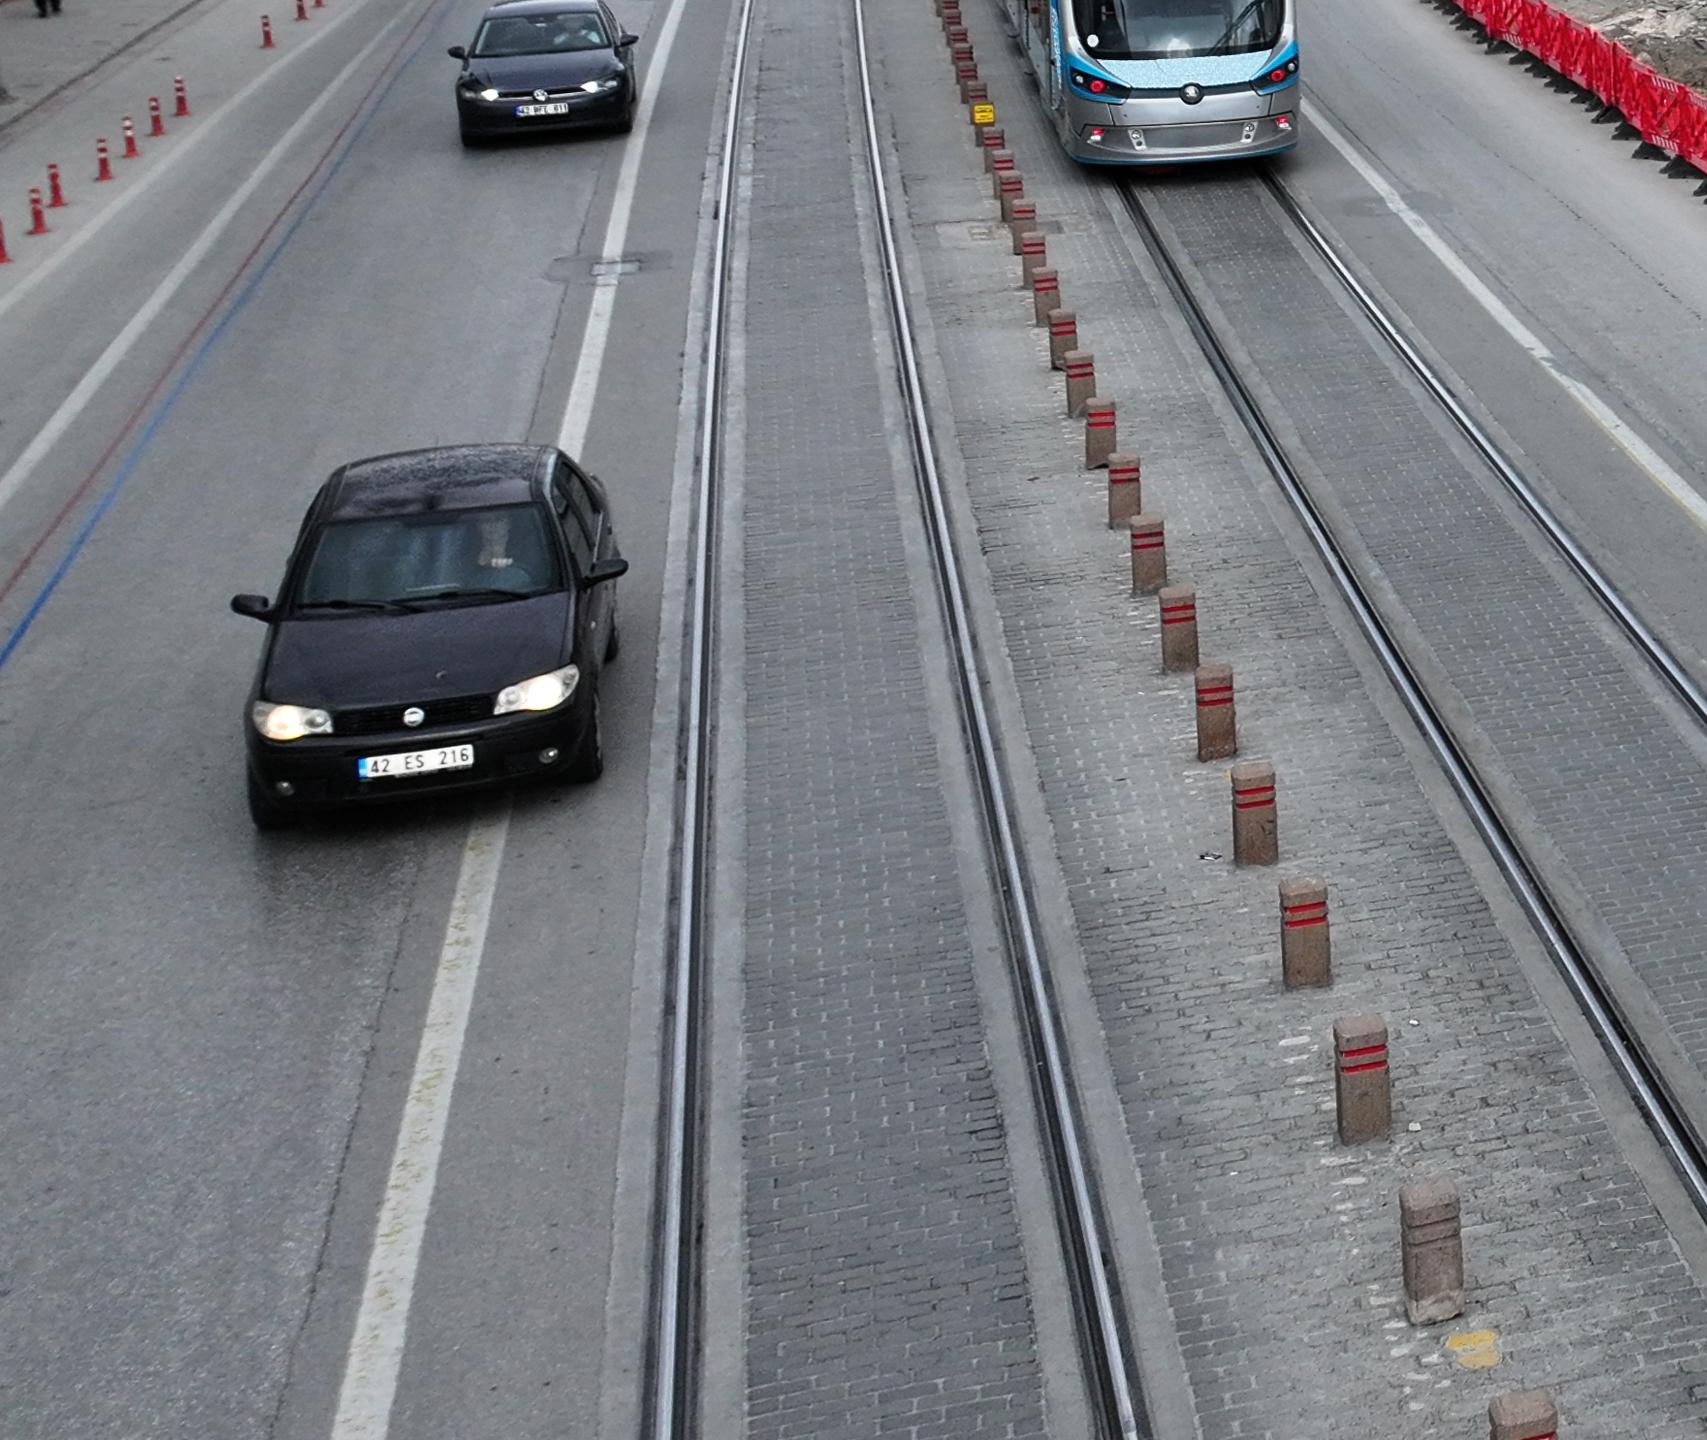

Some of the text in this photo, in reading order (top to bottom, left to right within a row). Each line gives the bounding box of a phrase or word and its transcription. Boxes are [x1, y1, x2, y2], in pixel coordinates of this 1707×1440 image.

[371, 747, 469, 773] 42 ES 216
